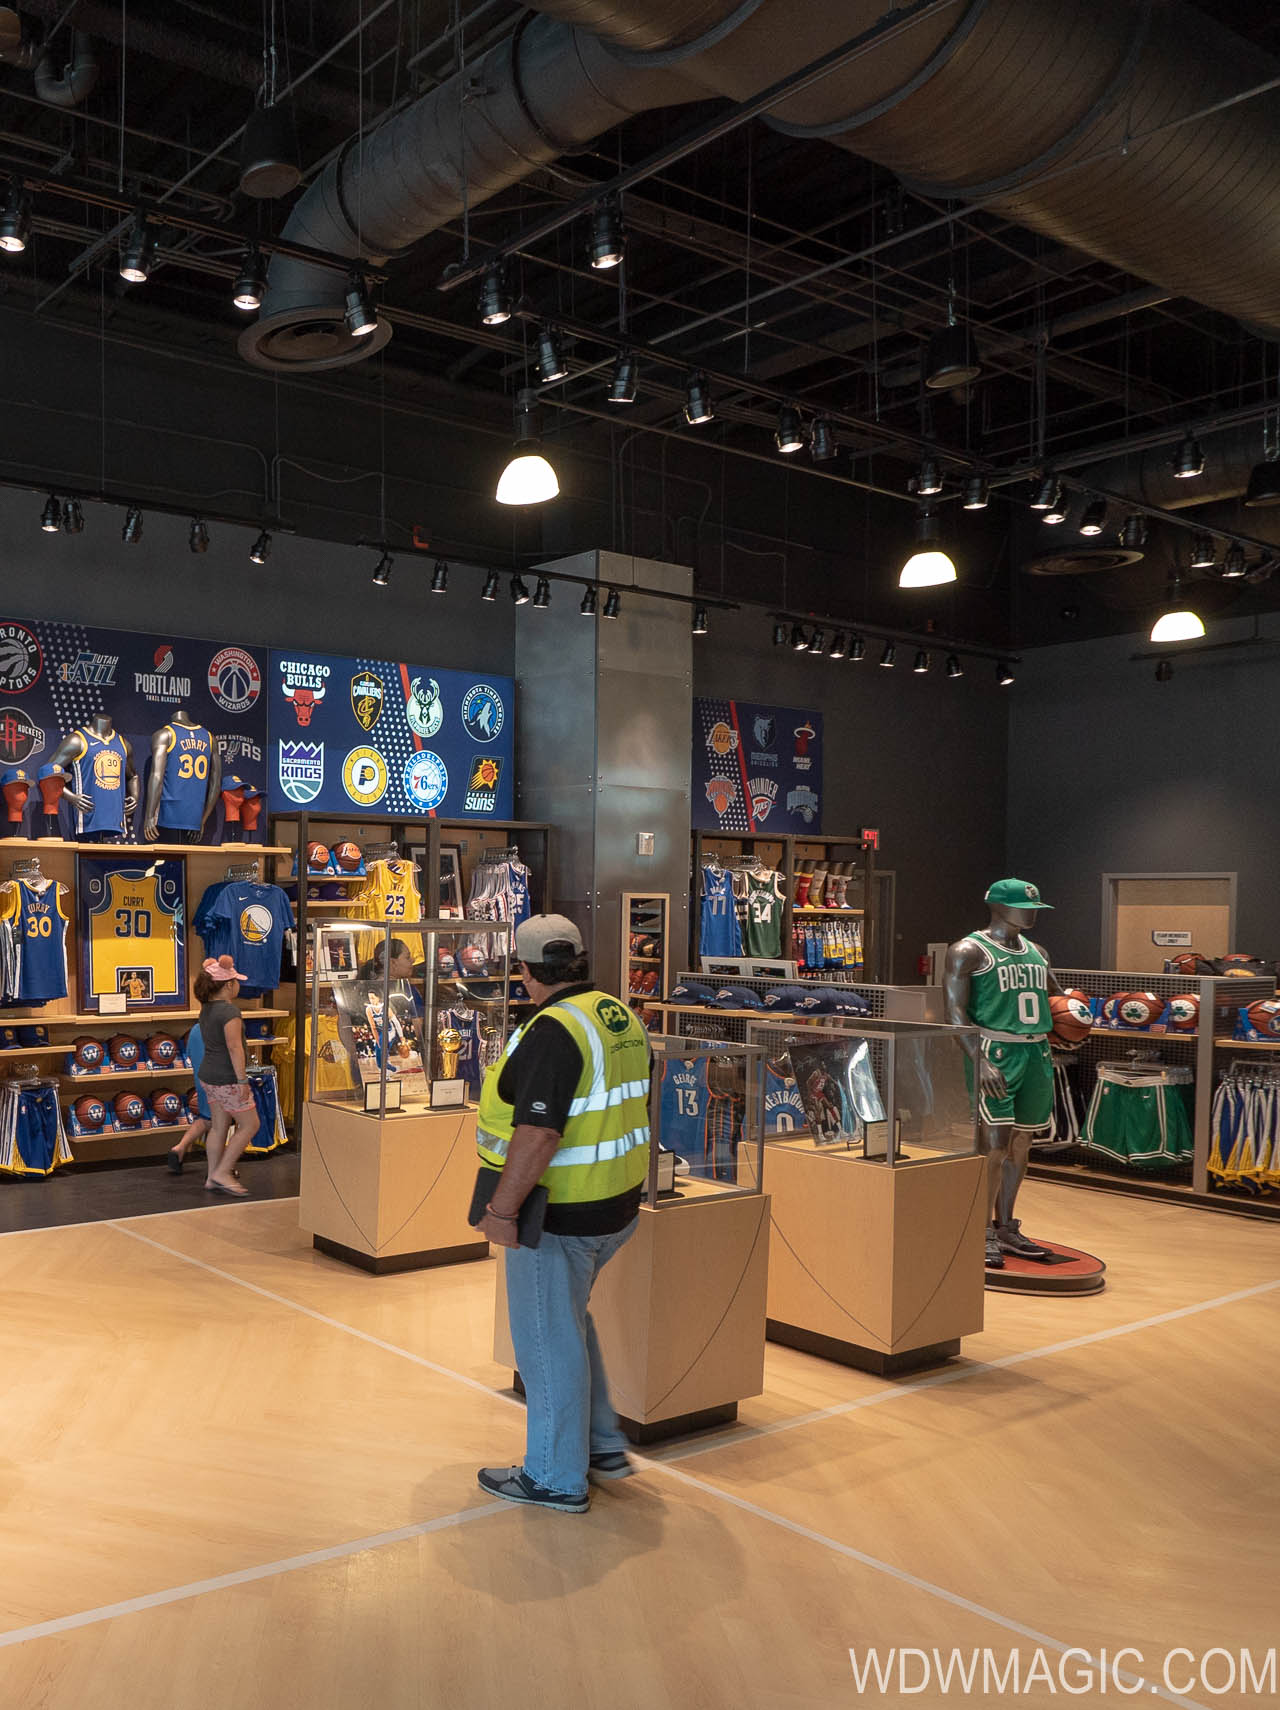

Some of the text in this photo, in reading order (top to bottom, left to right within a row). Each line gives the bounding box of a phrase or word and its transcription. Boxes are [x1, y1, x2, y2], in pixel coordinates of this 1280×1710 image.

[96, 654, 119, 665] UTAH
[214, 649, 255, 670] WASHINGTON
[280, 661, 330, 677] CHICAGO
[134, 672, 191, 697] PORTLAND
[286, 674, 322, 688] BULLS
[219, 697, 251, 710] WIZARDS
[464, 687, 482, 720] MINNESOTA
[17, 724, 42, 740] ROCKETS
[228, 734, 254, 744] ANTONIO
[180, 738, 208, 752] CURRY
[217, 740, 261, 762] PURS
[107, 759, 118, 767] 30
[178, 754, 208, 780] 30
[281, 766, 322, 779] KINGS
[405, 752, 447, 782] PHILADELPHIA
[413, 775, 438, 790] 76ers
[747, 777, 778, 800] THUNDER
[464, 797, 495, 811] SUNS
[123, 896, 145, 907] CURRY
[384, 894, 406, 917] 23
[753, 902, 771, 923] 34
[27, 916, 52, 938] 30
[115, 908, 152, 938] 30
[600, 1005, 628, 1025] PCL
[1018, 992, 1040, 1025] 0
[676, 1088, 699, 1117] 13
